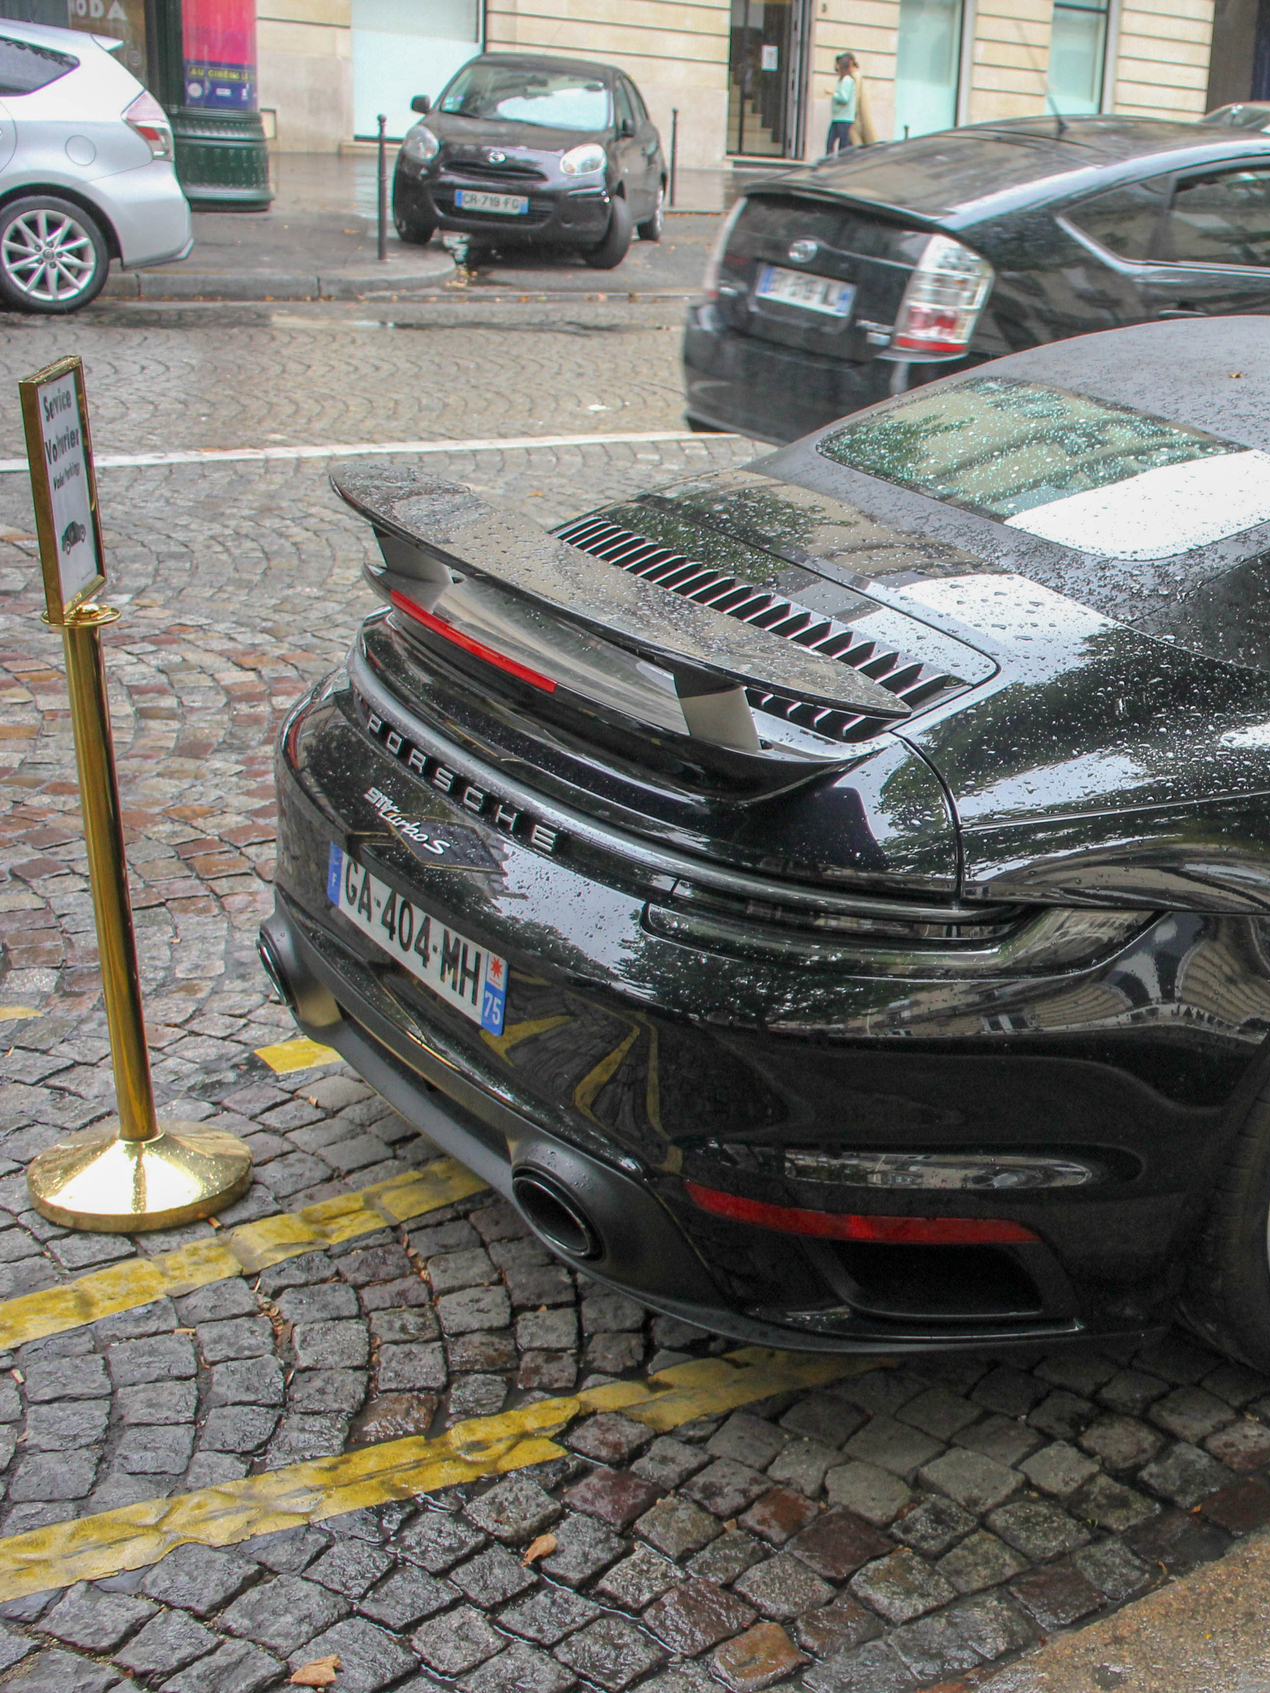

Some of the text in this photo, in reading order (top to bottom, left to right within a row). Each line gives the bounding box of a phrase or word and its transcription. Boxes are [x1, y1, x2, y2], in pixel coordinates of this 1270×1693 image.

[366, 712, 560, 853] PORSCHE
[422, 839, 451, 855] S
[345, 857, 482, 1006] GA-404-MH
[484, 992, 502, 1025] 75
